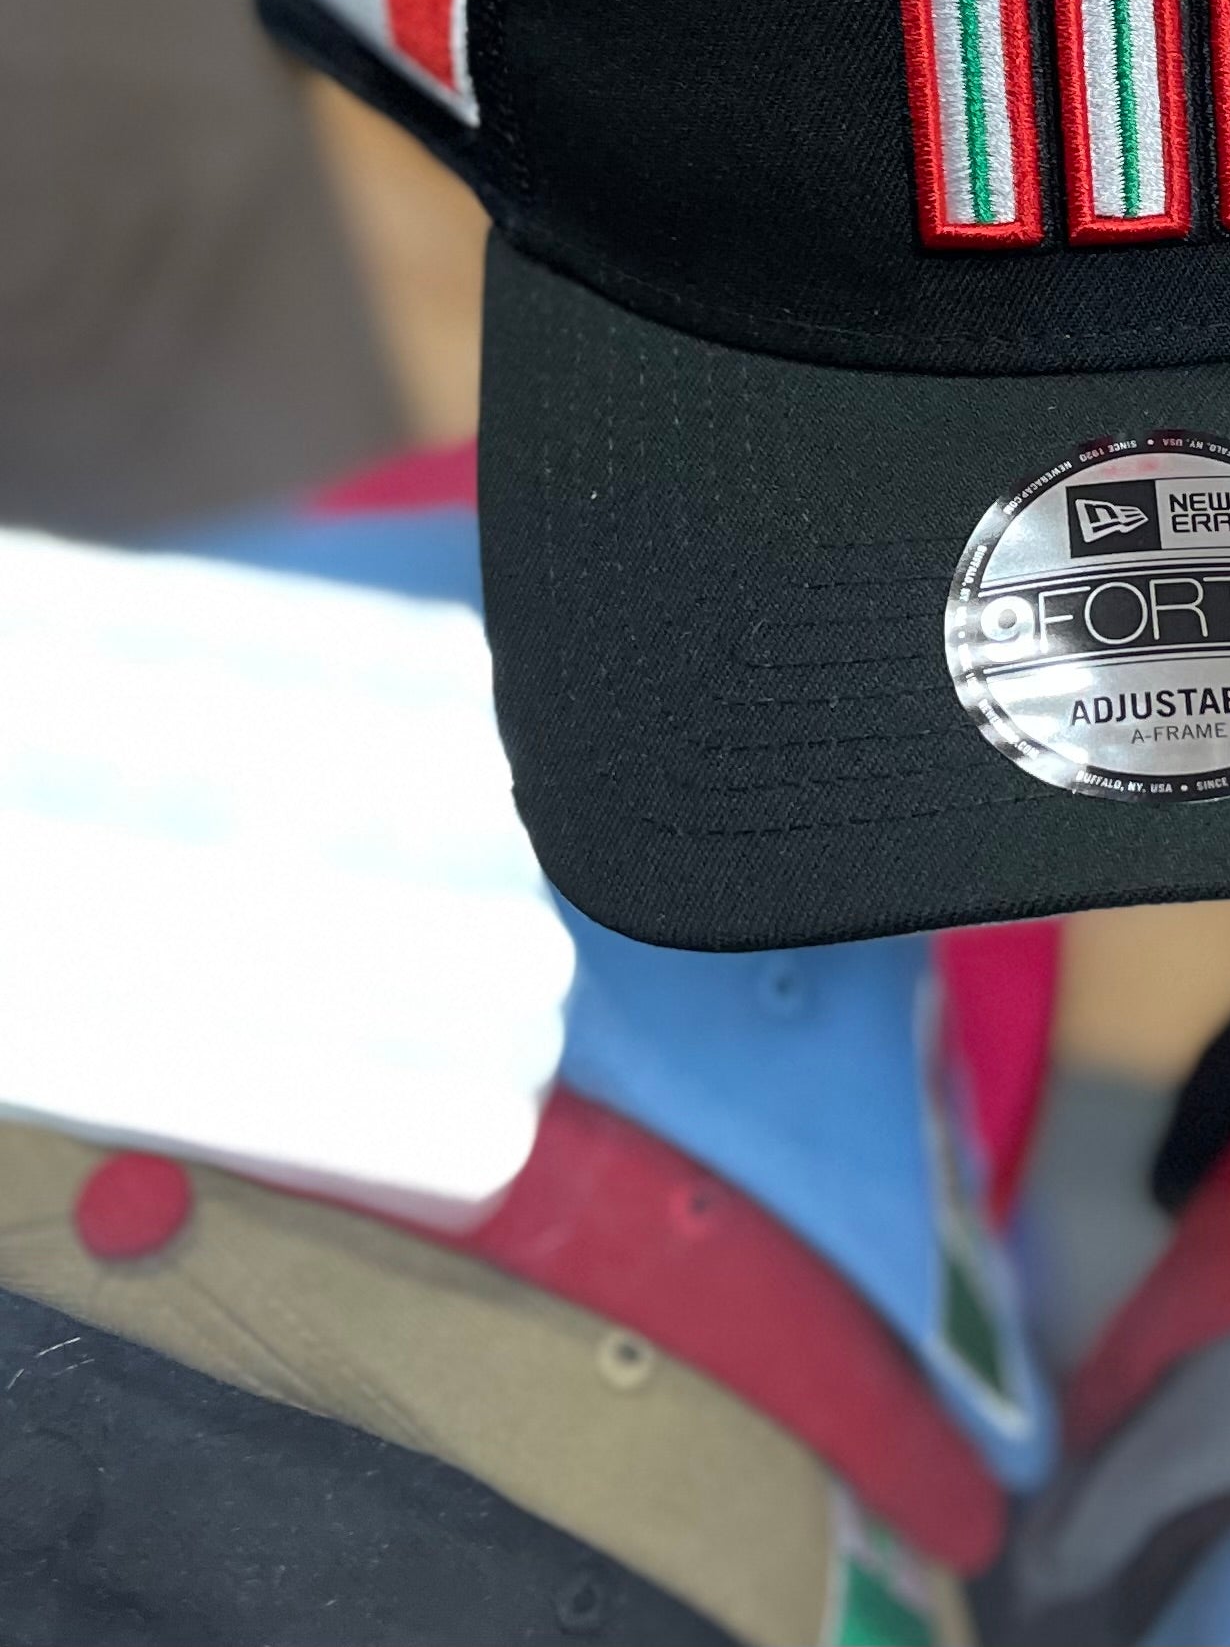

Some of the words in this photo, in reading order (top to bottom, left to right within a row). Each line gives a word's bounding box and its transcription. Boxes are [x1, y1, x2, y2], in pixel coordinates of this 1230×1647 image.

[1107, 439, 1138, 454] SINCE
[1162, 437, 1183, 448] USA
[1002, 460, 1073, 516] NEWERACAP.COM
[1131, 722, 1229, 745] A-FRAME
[1150, 783, 1174, 794] USA
[1196, 777, 1229, 792] SINCE
